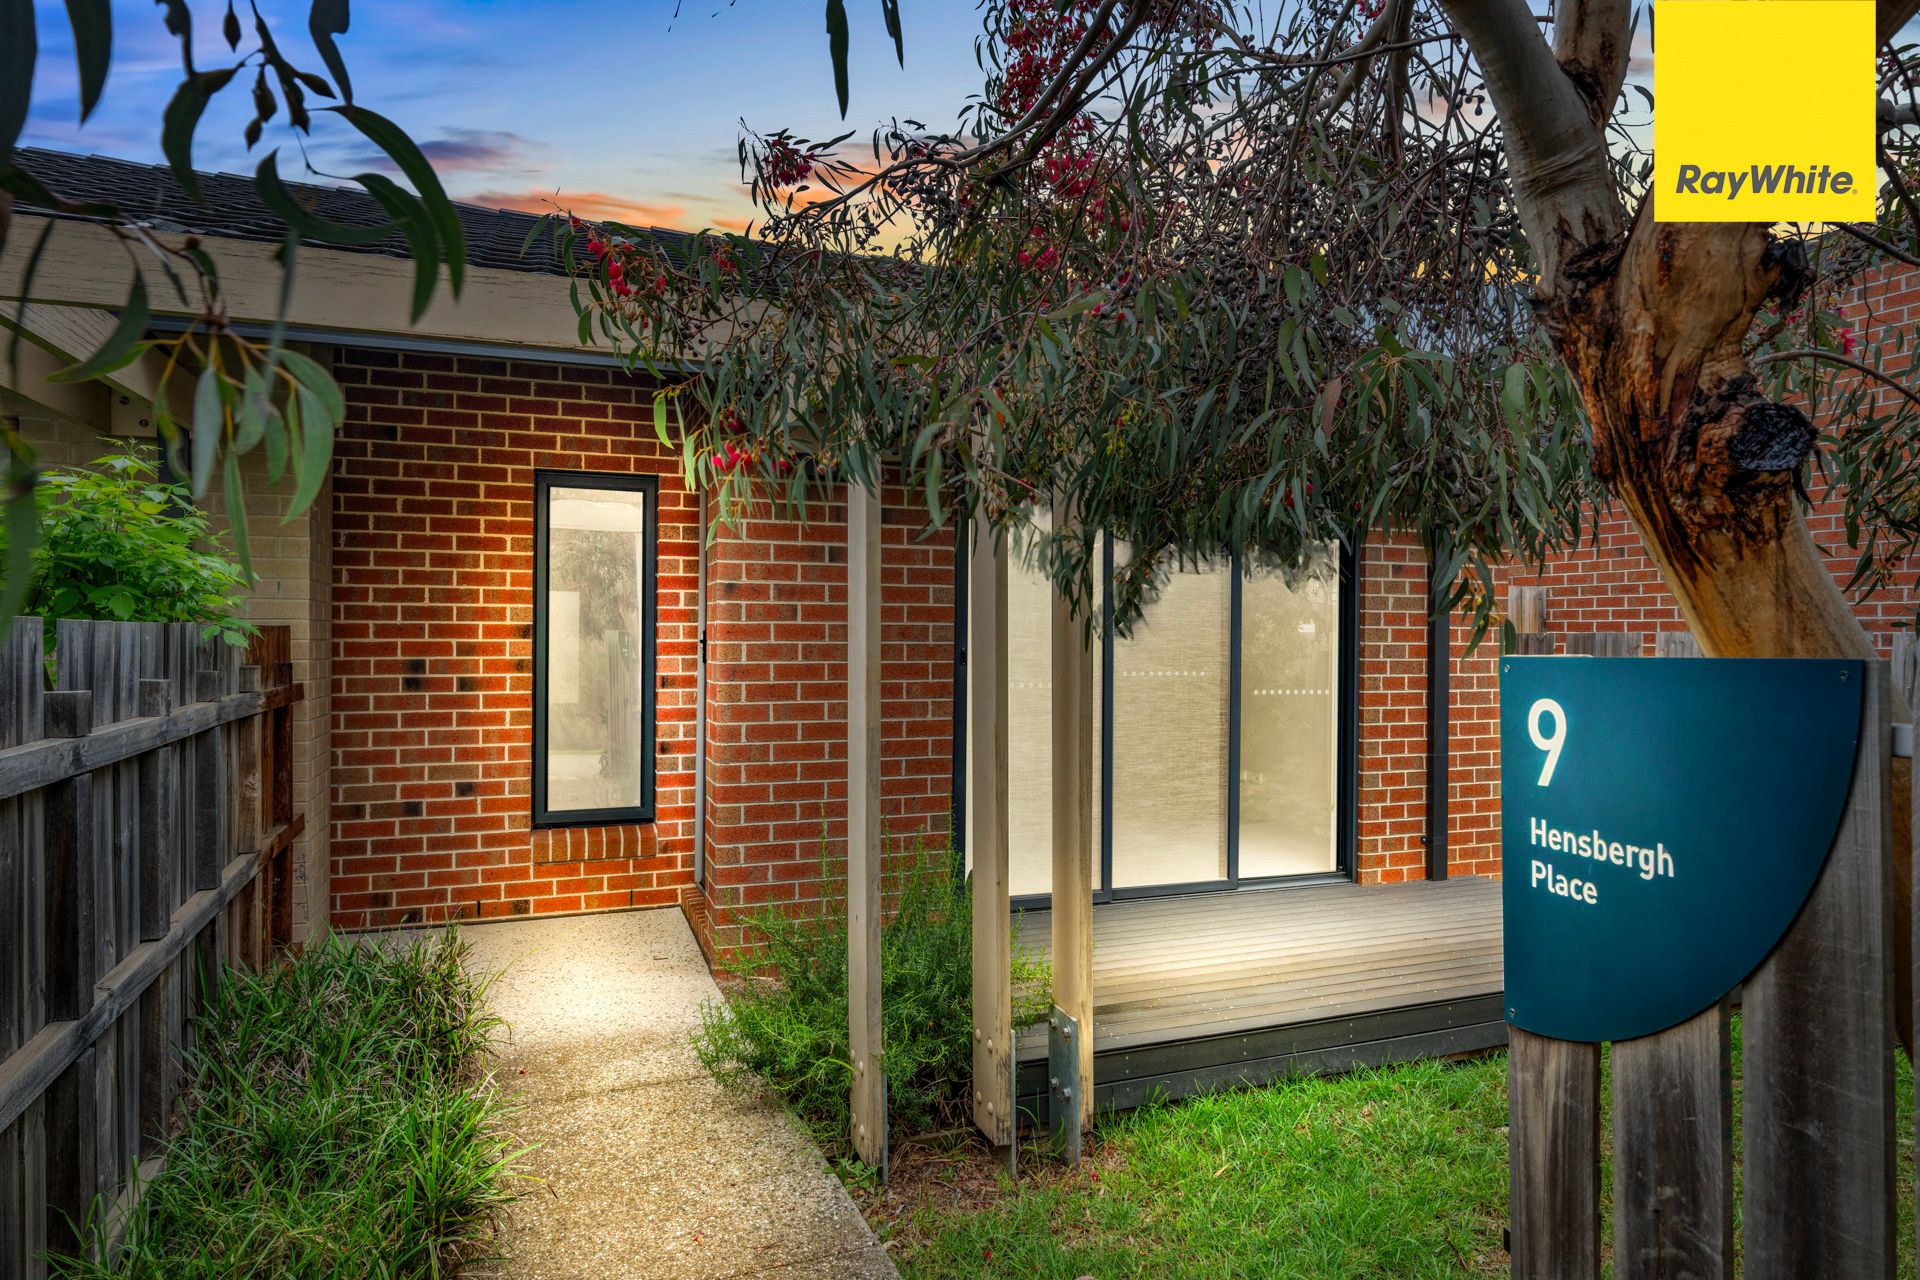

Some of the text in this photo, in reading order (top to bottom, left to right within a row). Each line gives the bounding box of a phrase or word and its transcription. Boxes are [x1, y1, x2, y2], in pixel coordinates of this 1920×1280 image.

[1527, 698, 1567, 787] 9
[1530, 817, 1675, 881] Hensbergh
[1531, 860, 1598, 905] Place
